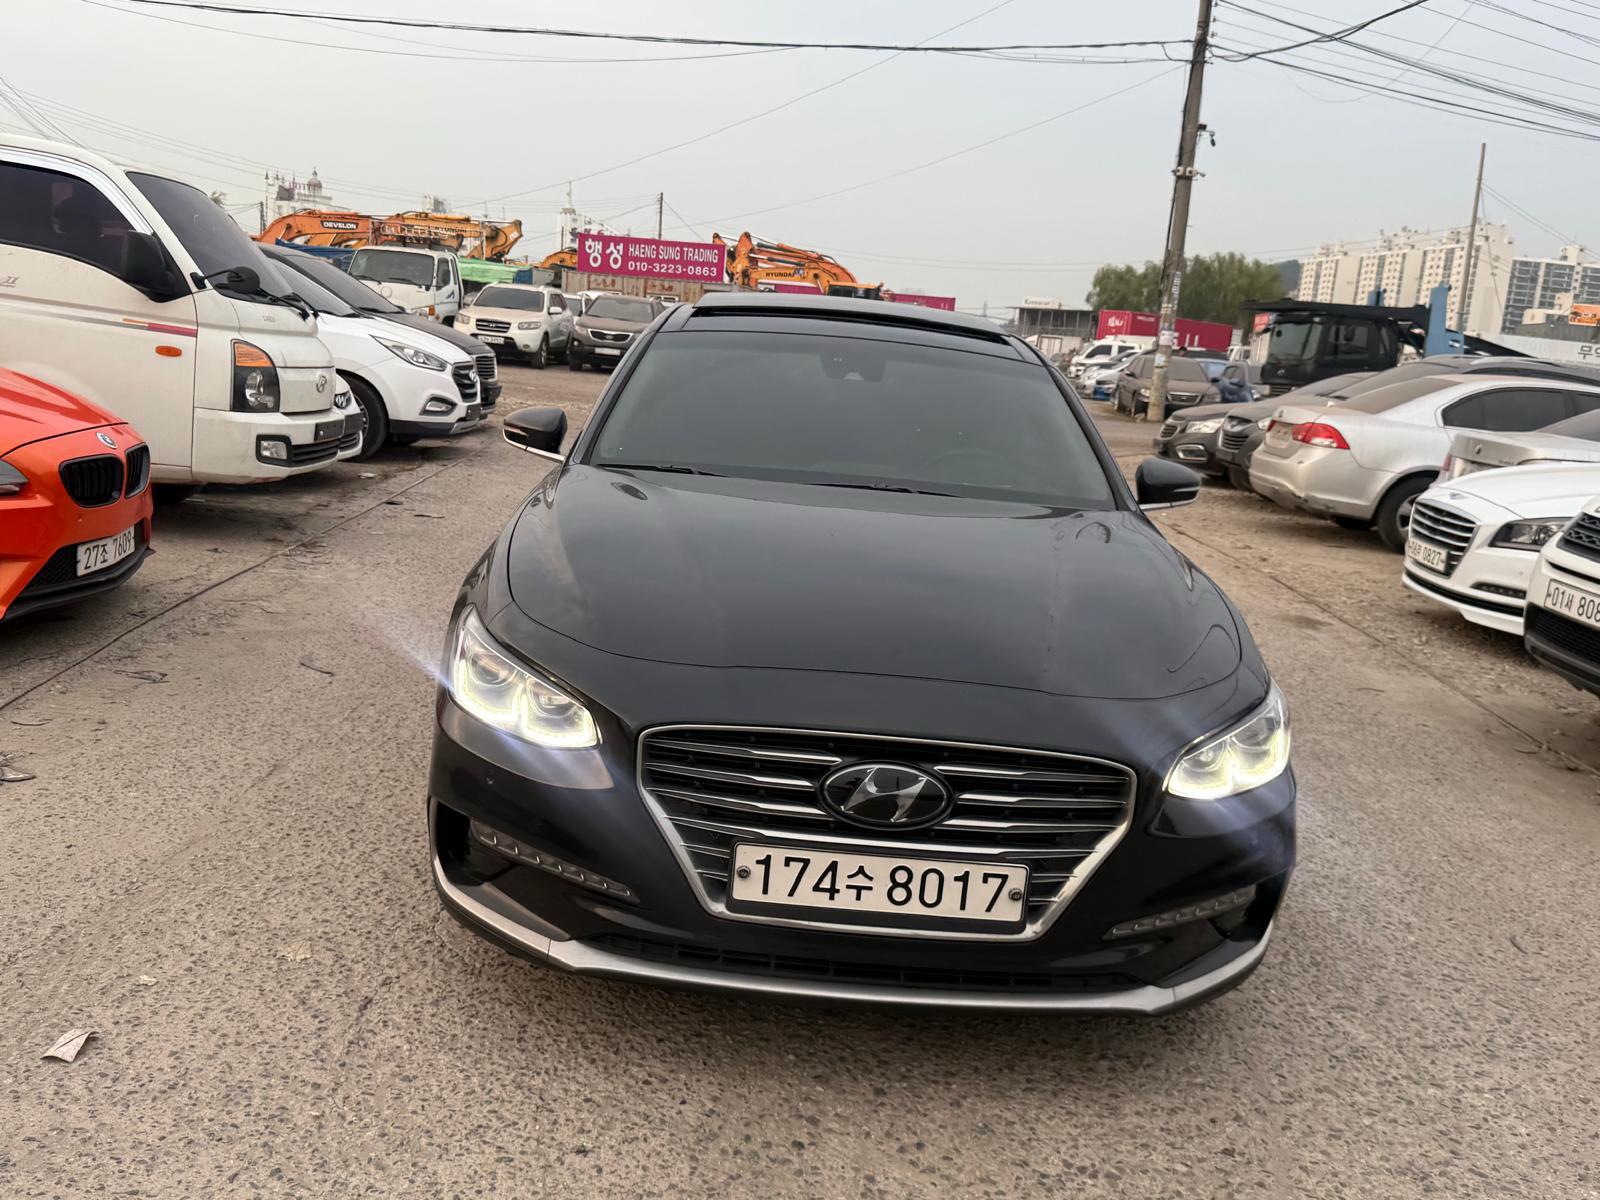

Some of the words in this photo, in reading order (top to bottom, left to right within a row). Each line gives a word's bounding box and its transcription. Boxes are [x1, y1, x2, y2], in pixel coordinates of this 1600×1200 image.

[323, 221, 357, 229] DEVELON
[628, 243, 657, 259] HAENG
[659, 245, 681, 260] SUNG
[683, 247, 719, 263] TRADING
[628, 260, 718, 277] 010-3223-0863
[84, 543, 108, 570] 27조
[1422, 546, 1441, 566] 0827
[755, 854, 874, 902] 174수
[886, 865, 1009, 913] 8017
